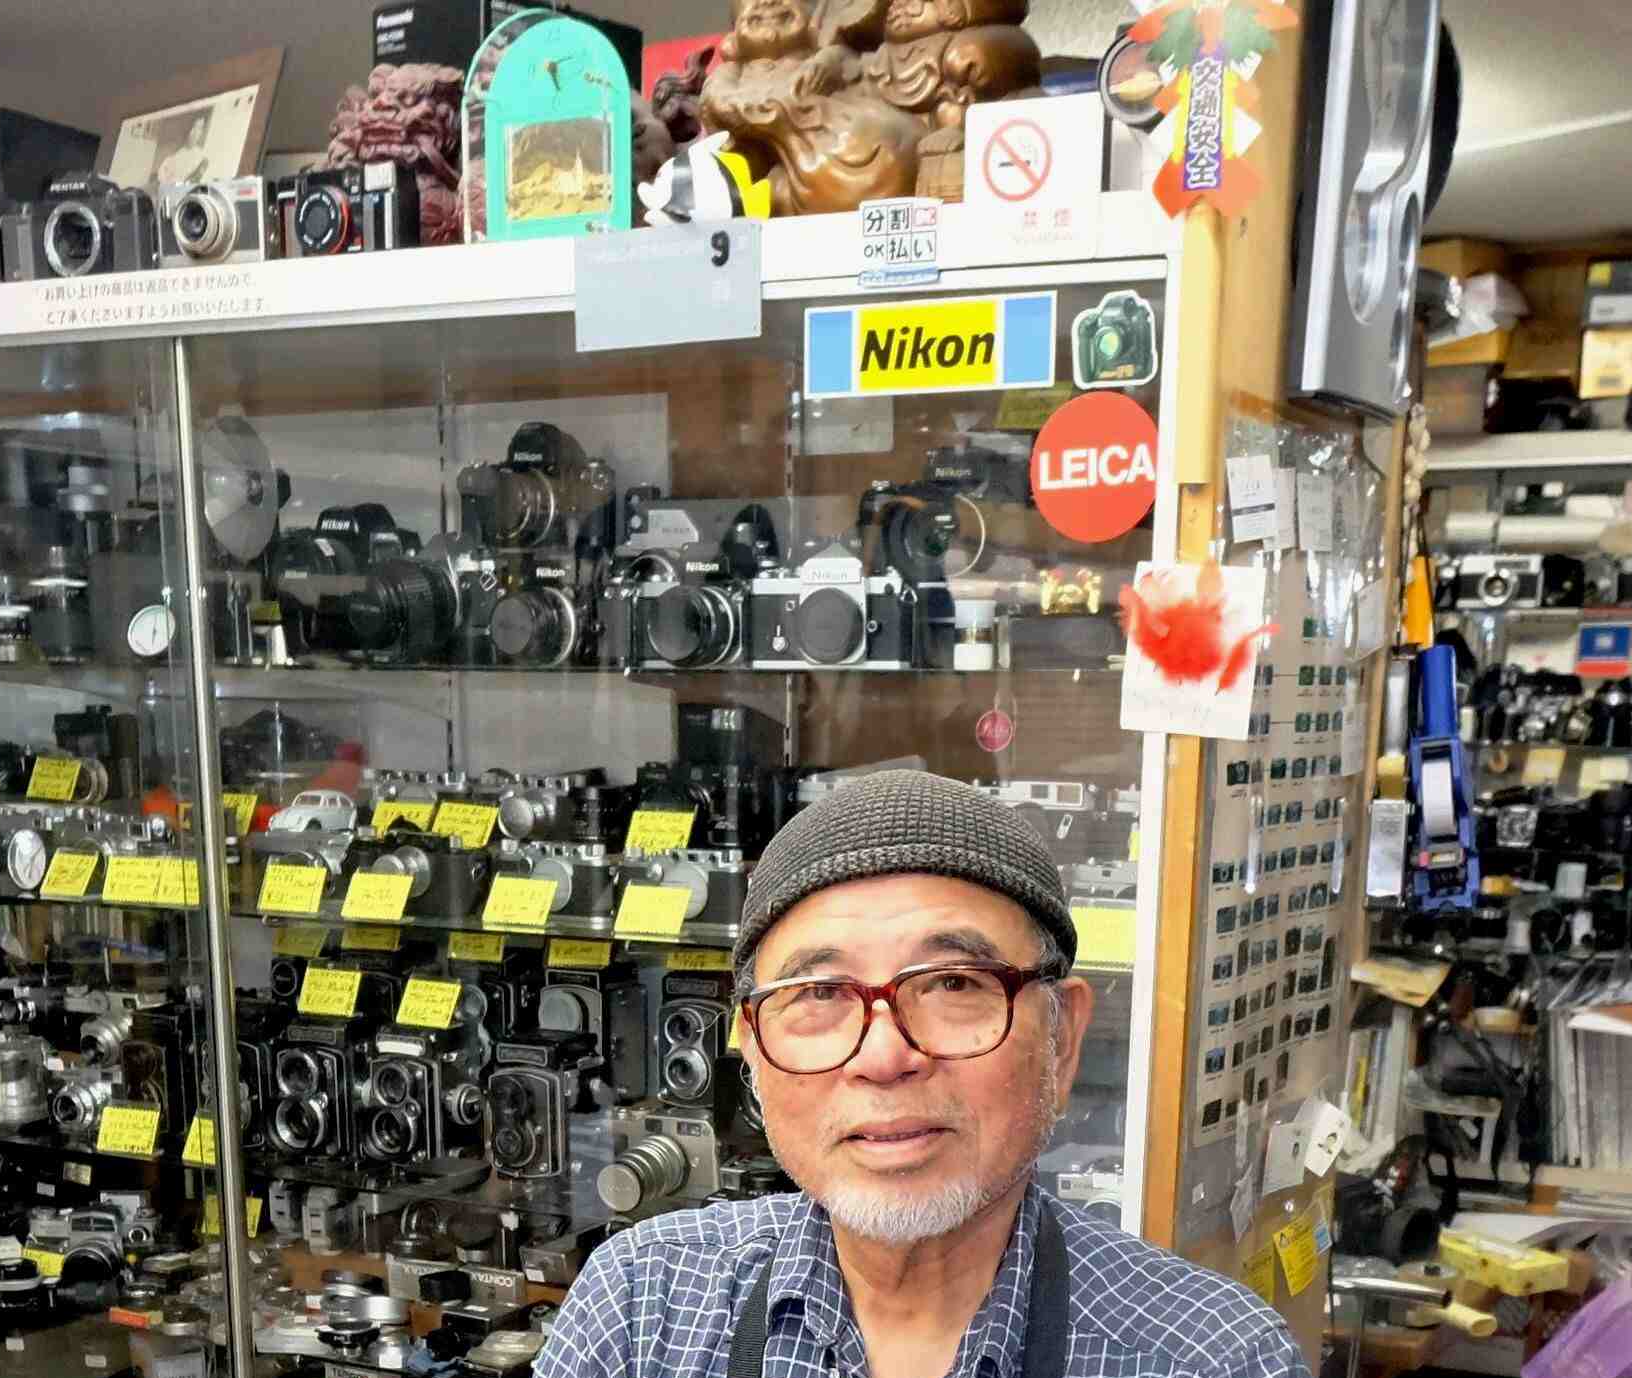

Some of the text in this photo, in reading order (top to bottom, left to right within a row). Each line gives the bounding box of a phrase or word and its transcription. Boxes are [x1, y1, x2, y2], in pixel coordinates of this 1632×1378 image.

[1187, 56, 1222, 191] 交通安全
[866, 207, 910, 233] 分割
[710, 230, 731, 267] 9
[863, 243, 885, 259] OK
[859, 325, 995, 373] Nikon
[513, 450, 542, 463] Nikon
[1038, 442, 1156, 491] LEICA
[320, 518, 350, 531] Nikon
[535, 566, 566, 578] Nikon
[685, 559, 720, 573] Nikon
